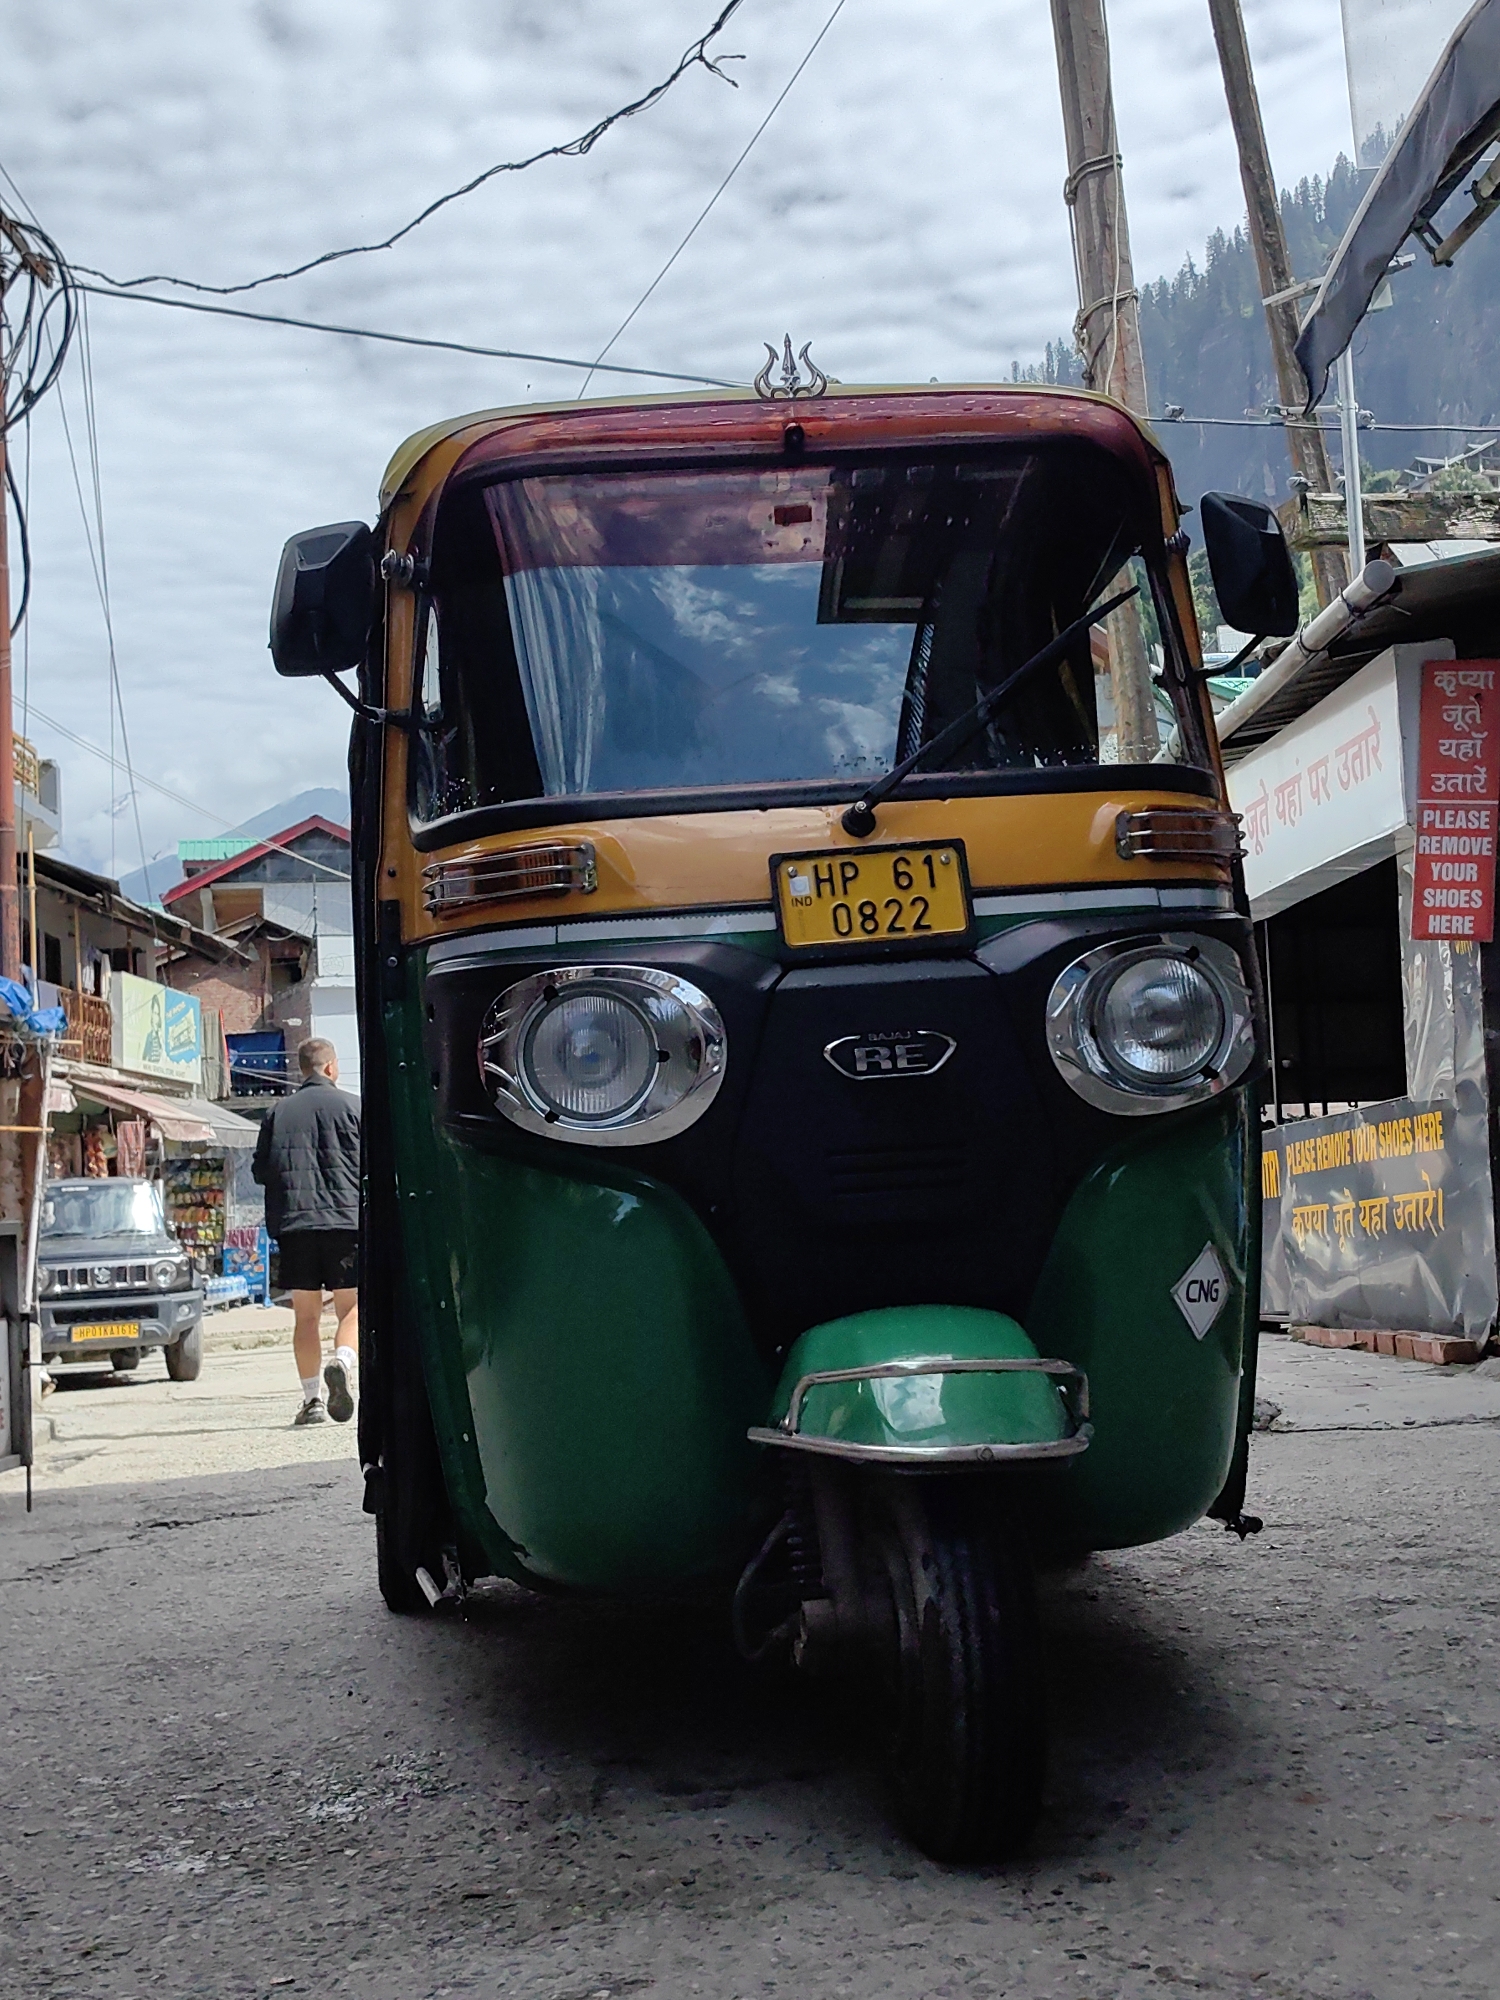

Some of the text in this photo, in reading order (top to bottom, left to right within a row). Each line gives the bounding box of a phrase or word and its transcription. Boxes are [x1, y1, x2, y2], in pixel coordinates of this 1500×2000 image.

[1442, 695, 1483, 733] जूते
[1244, 705, 1383, 856] जूते यहां पर उतारे
[1422, 809, 1491, 830] PLEASE
[1418, 835, 1493, 856] REMOVE
[813, 854, 936, 898] HP 61
[1430, 862, 1478, 882] YOUR
[791, 896, 813, 908] IND
[1422, 888, 1483, 909] SHOES
[832, 896, 932, 937] 0822
[1428, 915, 1475, 935] HERE
[867, 1031, 912, 1042] BAJAJ
[854, 1044, 929, 1072] RE
[1285, 1110, 1445, 1176] PLEASE REMOVE YOUR SHOES HERE
[1291, 1203, 1330, 1253] कृपया
[1332, 1187, 1357, 1254] जूते
[1185, 1278, 1220, 1303] CNG
